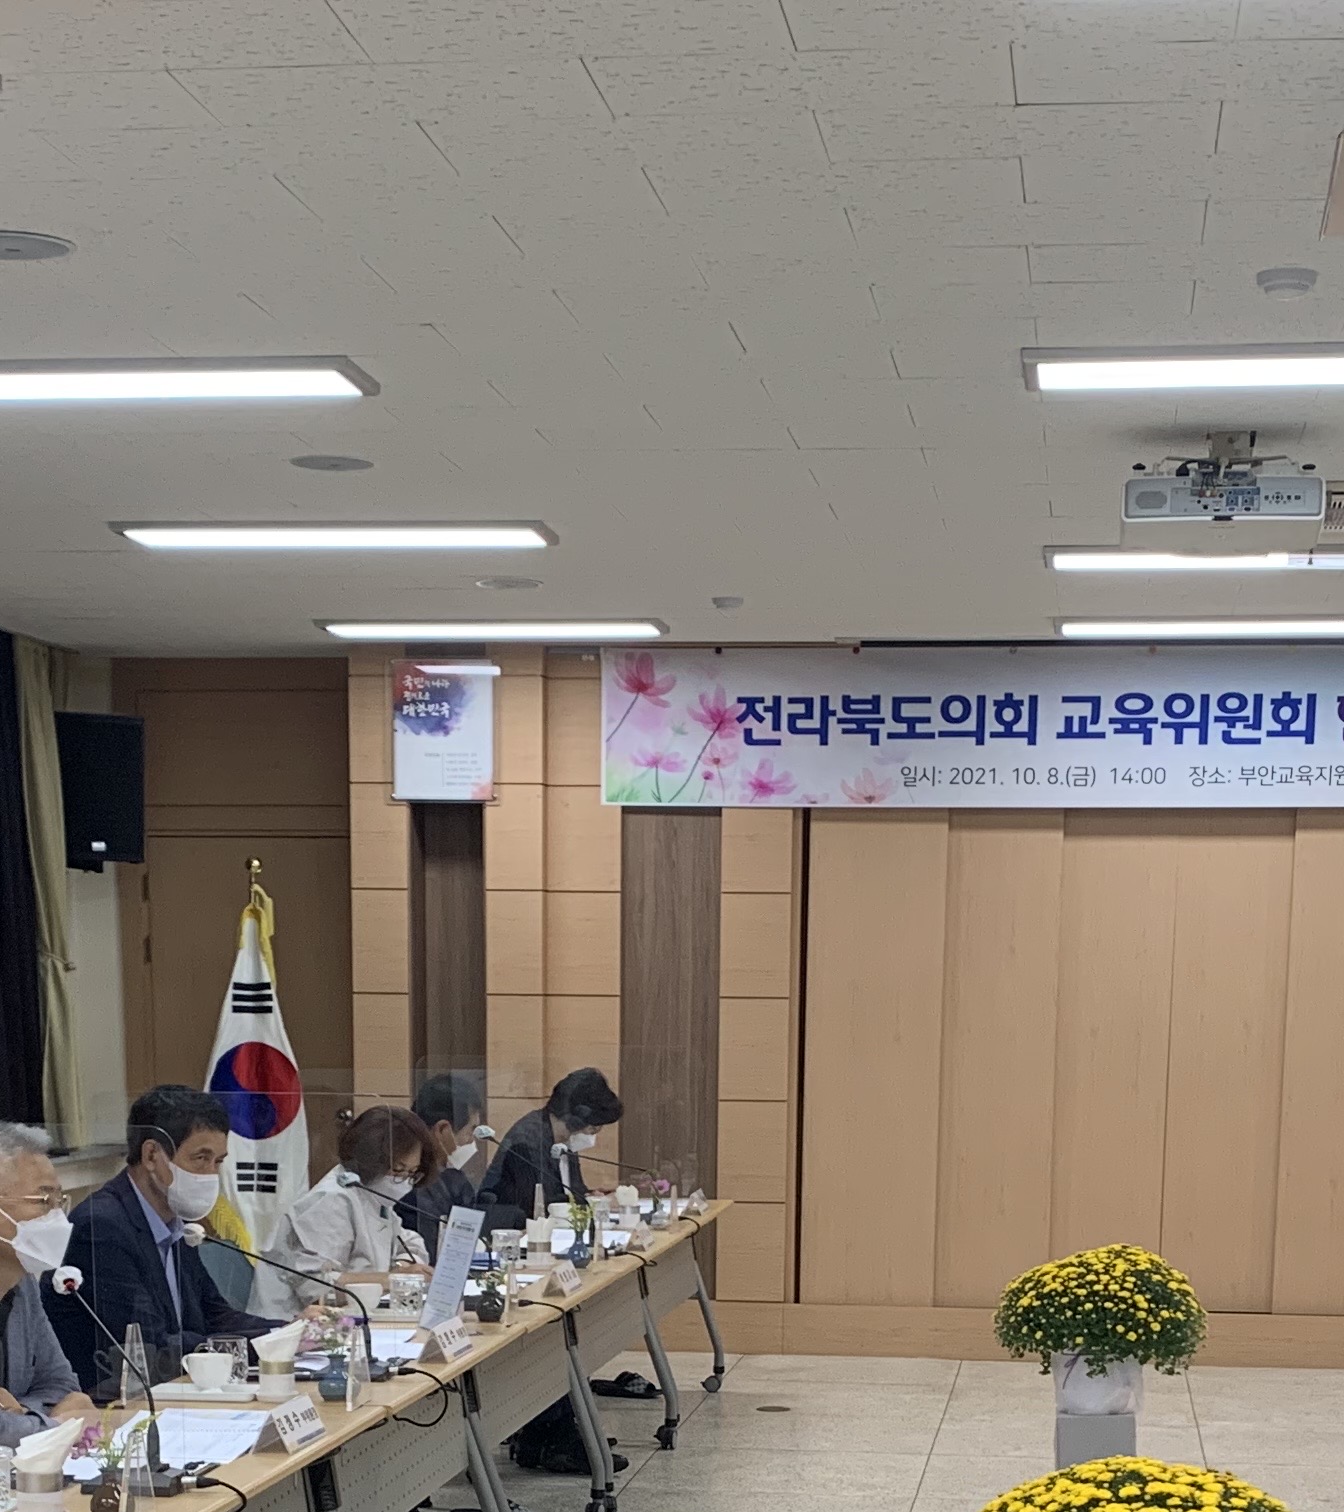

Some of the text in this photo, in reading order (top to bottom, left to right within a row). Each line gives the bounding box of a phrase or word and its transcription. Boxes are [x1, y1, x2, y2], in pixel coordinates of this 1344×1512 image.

[401, 701, 451, 719] 대한민국
[736, 692, 1039, 746] 전라북도의회
[1056, 691, 1317, 746] 교육위원회
[900, 765, 943, 788] 일시:
[949, 766, 1004, 786] 2021.
[1013, 766, 1041, 786] 10.
[1109, 766, 1167, 785] 14:00
[1189, 764, 1232, 787] 장소:
